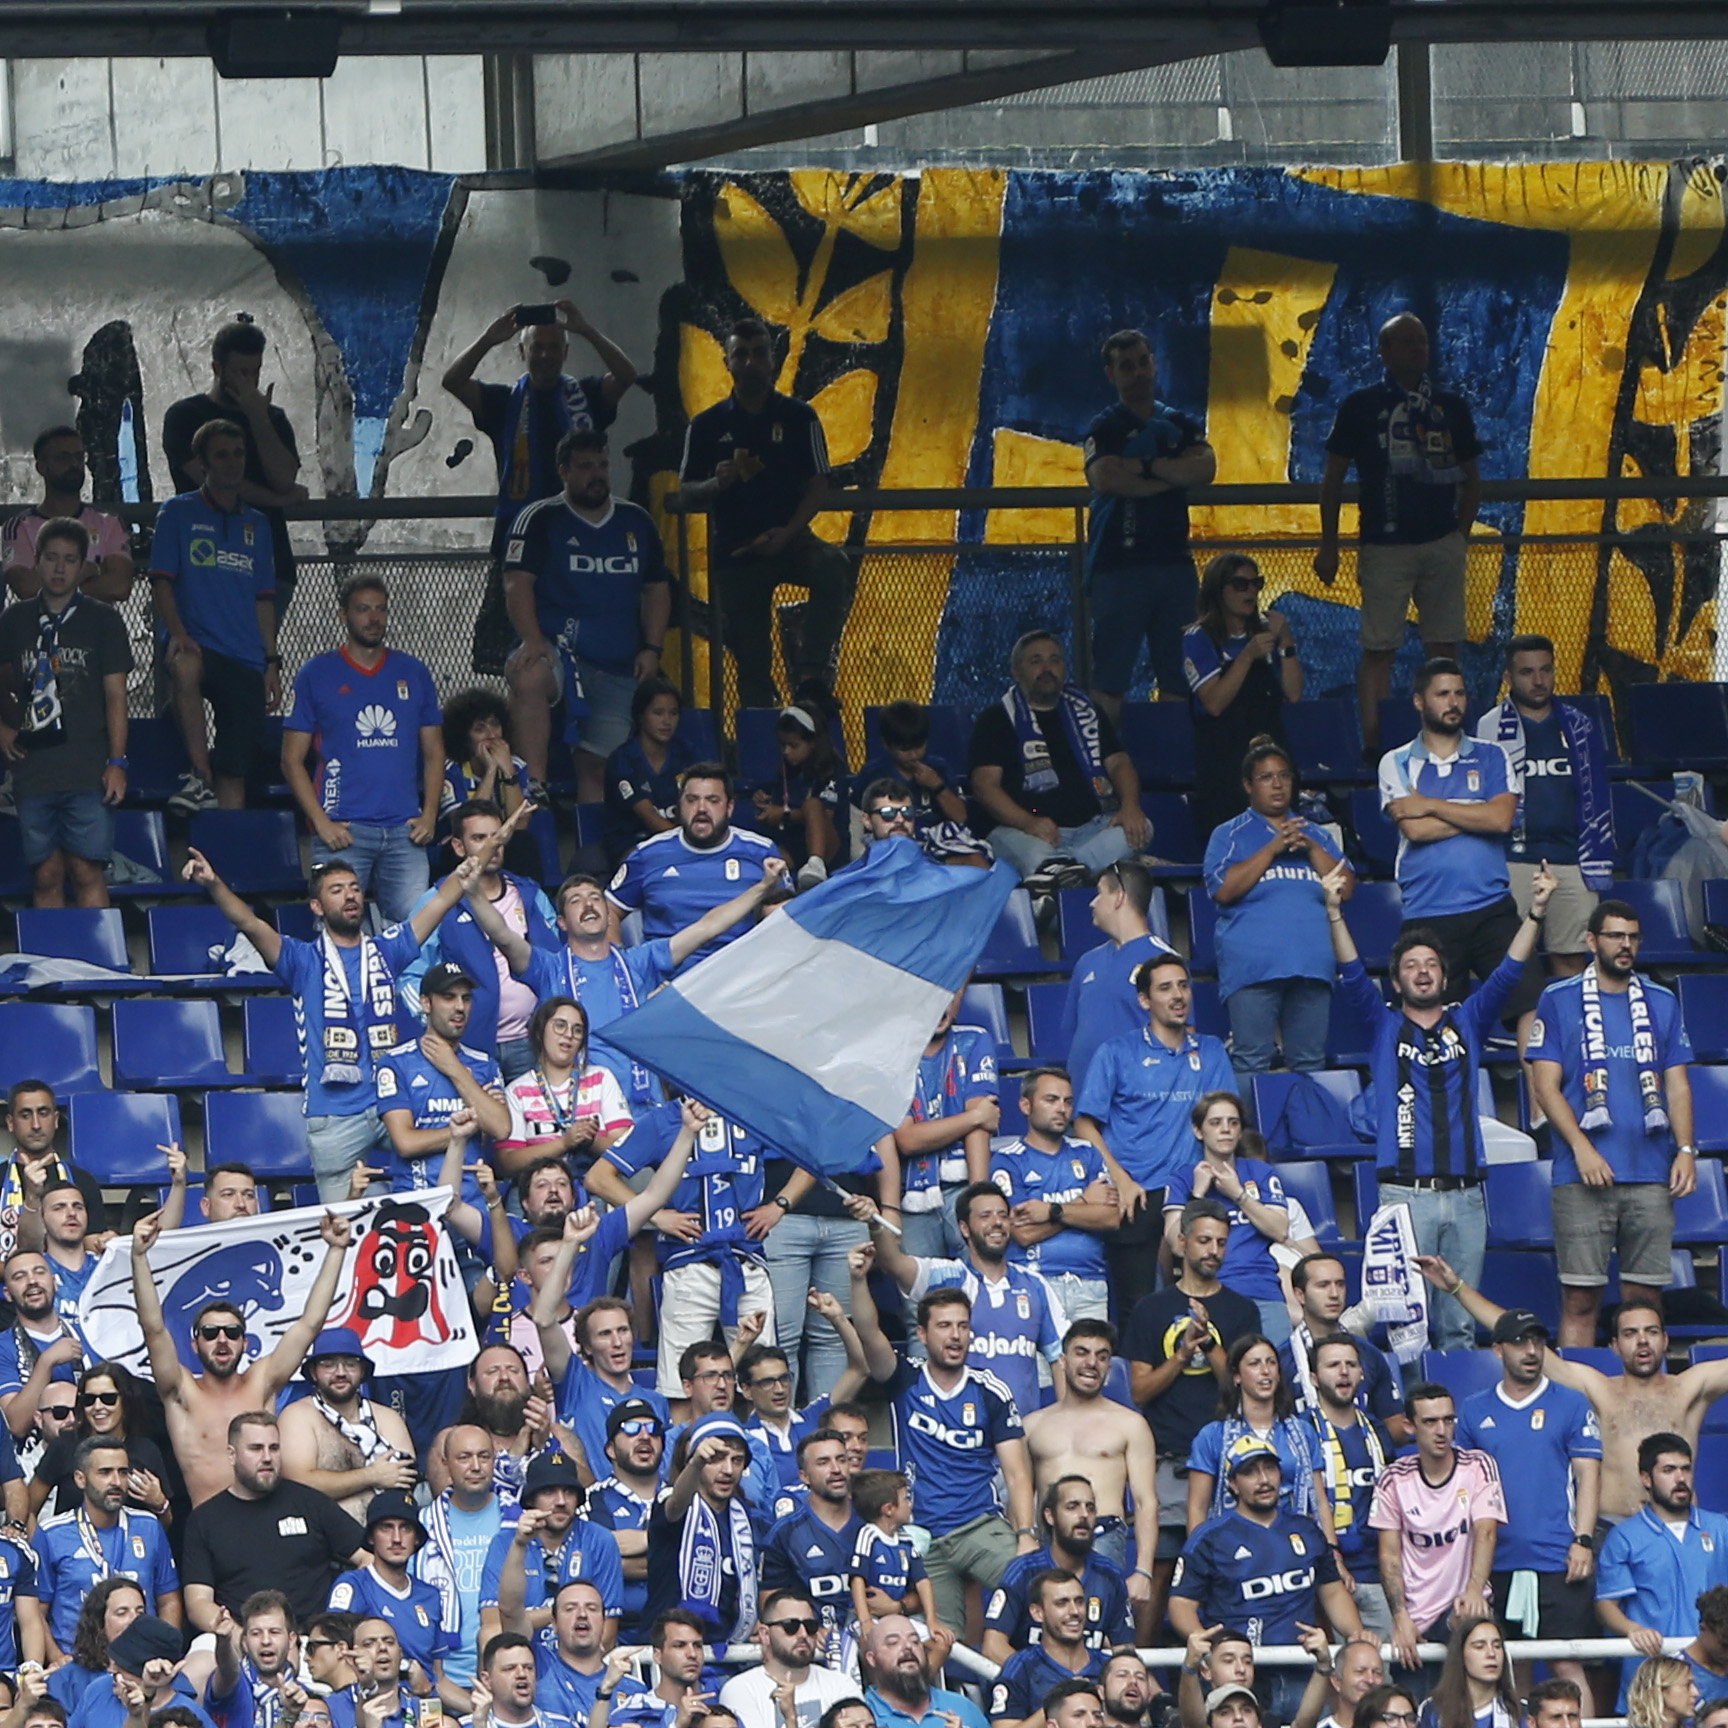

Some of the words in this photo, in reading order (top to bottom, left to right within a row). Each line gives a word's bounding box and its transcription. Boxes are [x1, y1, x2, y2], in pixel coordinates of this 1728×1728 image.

[569, 555, 638, 574] DIGI
[356, 739, 399, 749] HUAWEI
[1523, 756, 1571, 777] DIG
[967, 1332, 1037, 1359] ajastu
[908, 1410, 984, 1450] DIGI
[1408, 1519, 1470, 1549] DIGI
[1242, 1566, 1314, 1600] DIGI
